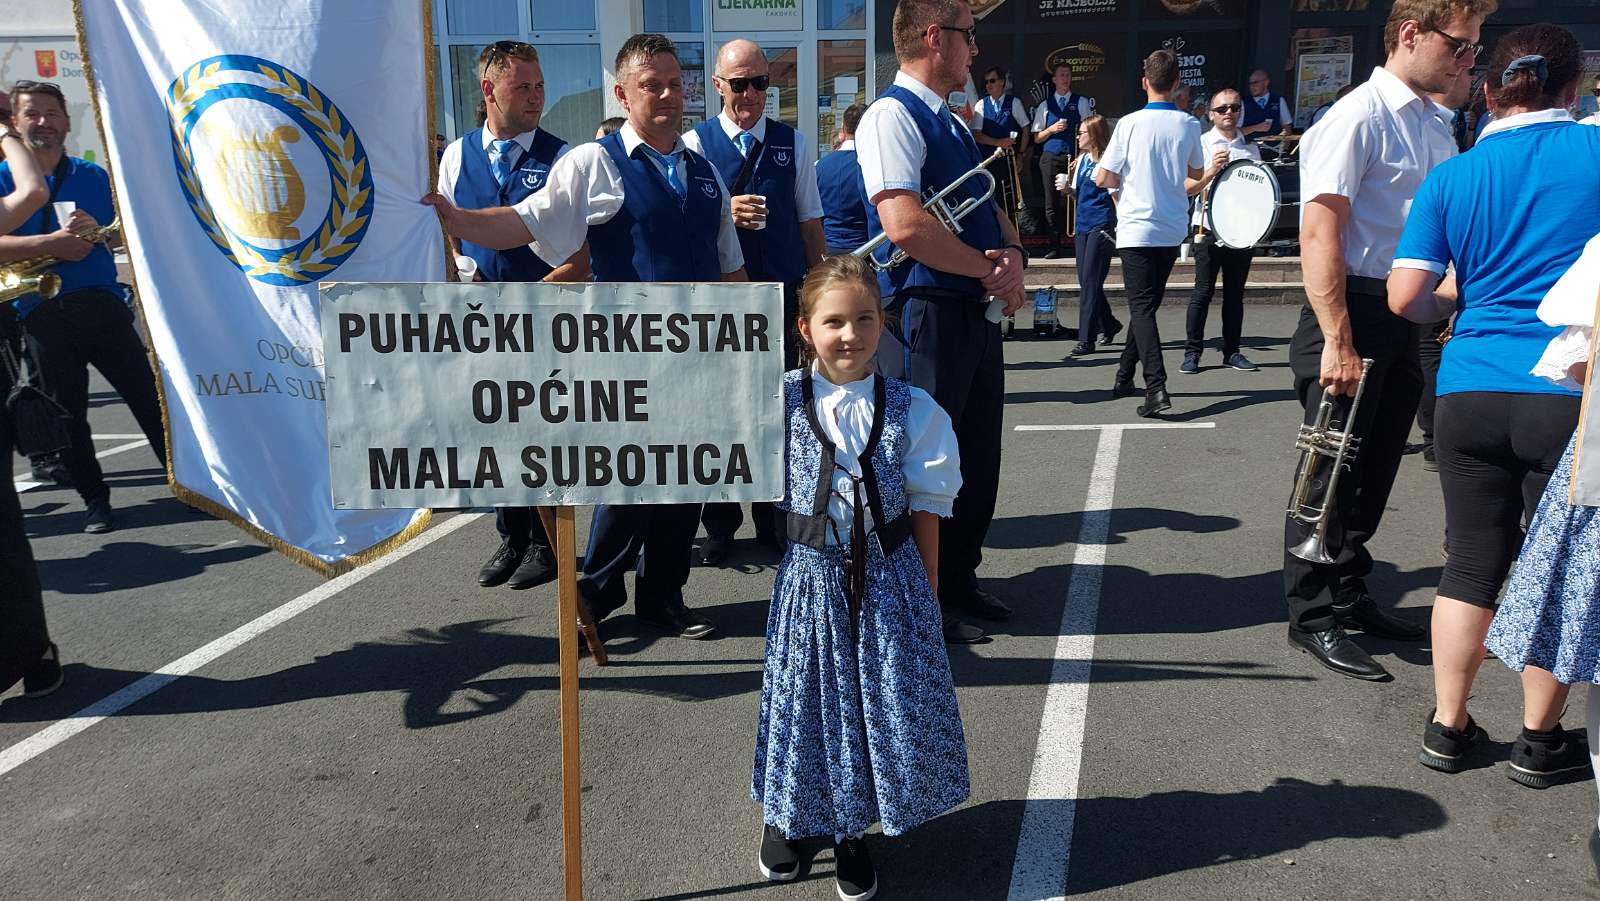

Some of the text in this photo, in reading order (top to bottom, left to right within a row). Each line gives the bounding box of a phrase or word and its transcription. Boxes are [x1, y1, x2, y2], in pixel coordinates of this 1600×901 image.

[718, 0, 796, 9] LJEKARNA
[1237, 169, 1265, 185] OLYMPIC
[339, 303, 770, 354] PUHAČKI ORKESTAR
[196, 371, 281, 396] MALA
[471, 368, 649, 424] OPĆINE
[367, 443, 753, 490] MALA SUBOTICA
